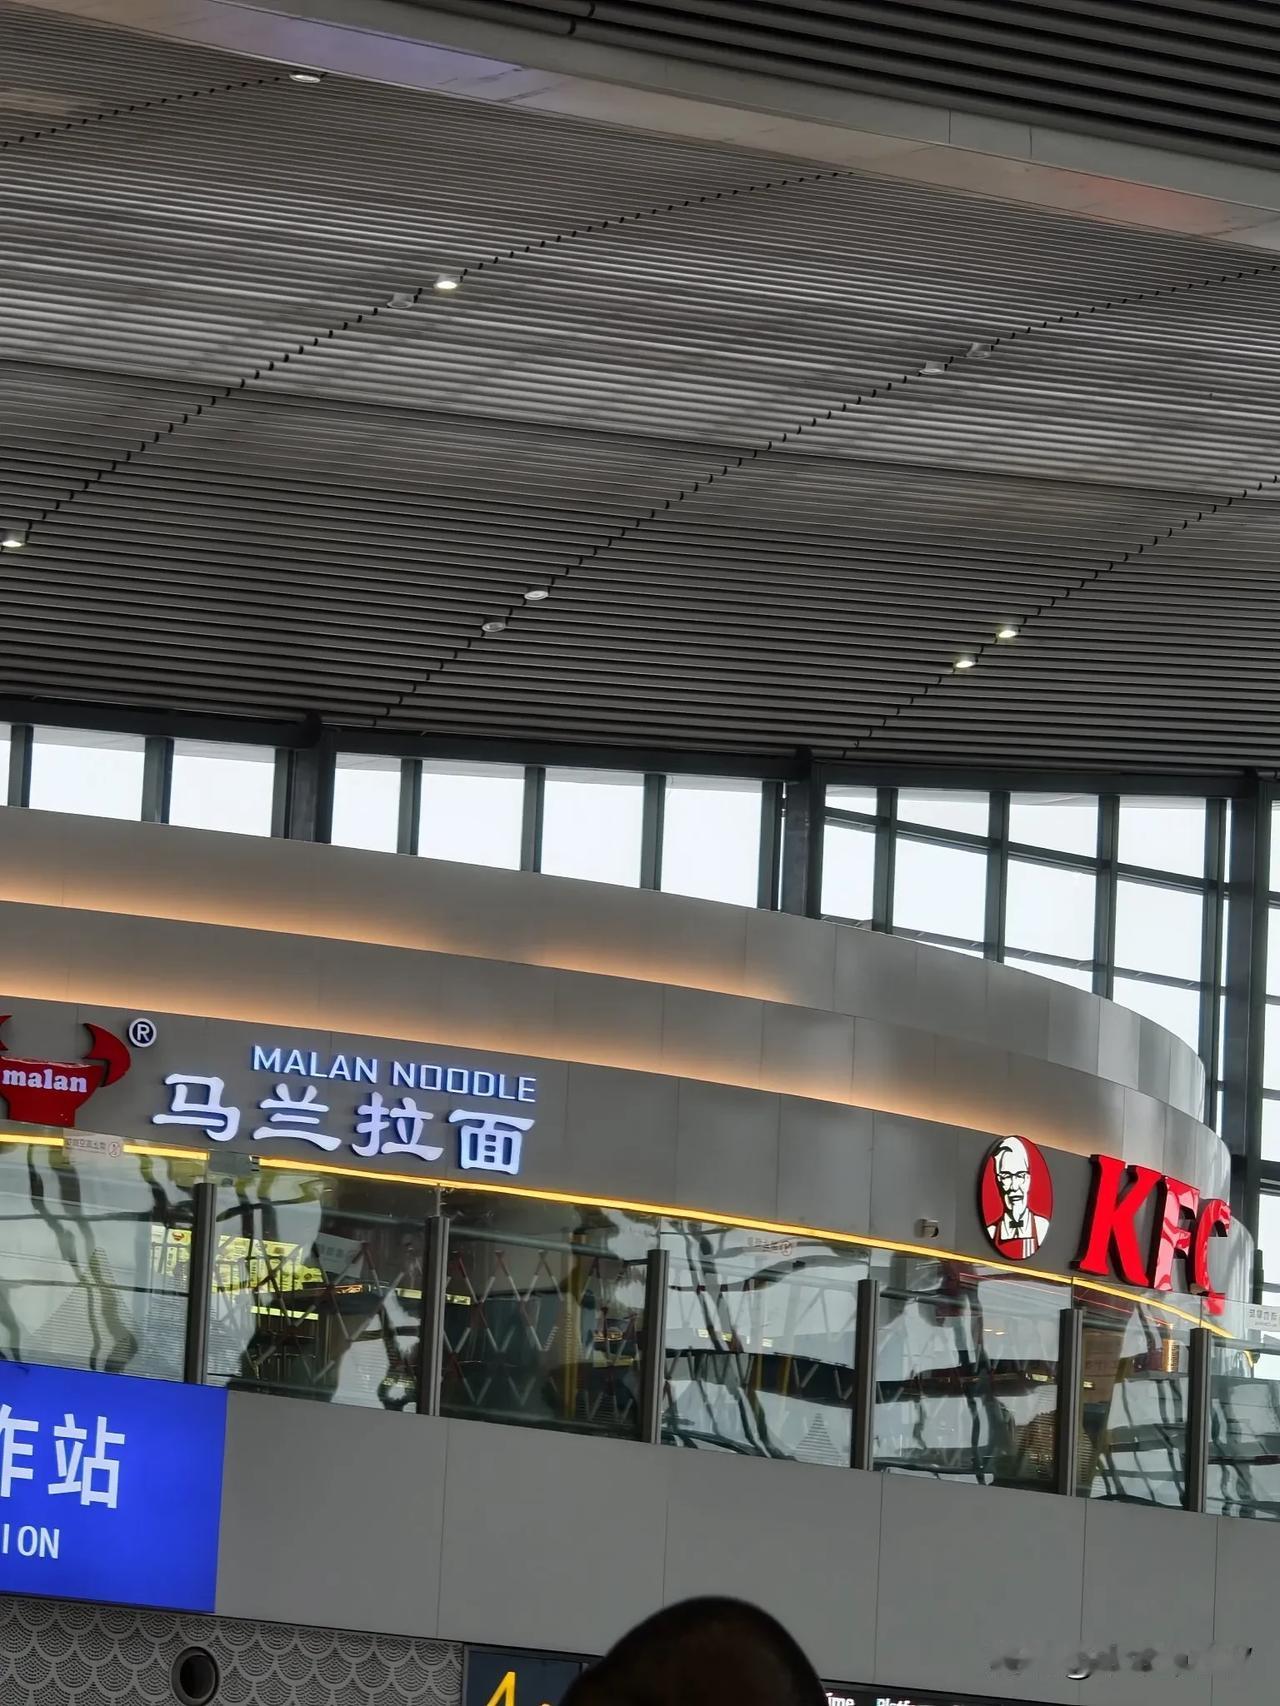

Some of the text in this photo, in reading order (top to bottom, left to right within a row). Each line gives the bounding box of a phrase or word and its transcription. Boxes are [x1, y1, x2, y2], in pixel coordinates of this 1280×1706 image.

[2, 1068, 87, 1093] malan
[252, 1045, 537, 1103] MALAN NOODLE
[152, 1073, 535, 1175] 马兰拉面
[1078, 1154, 1231, 1316] KFC
